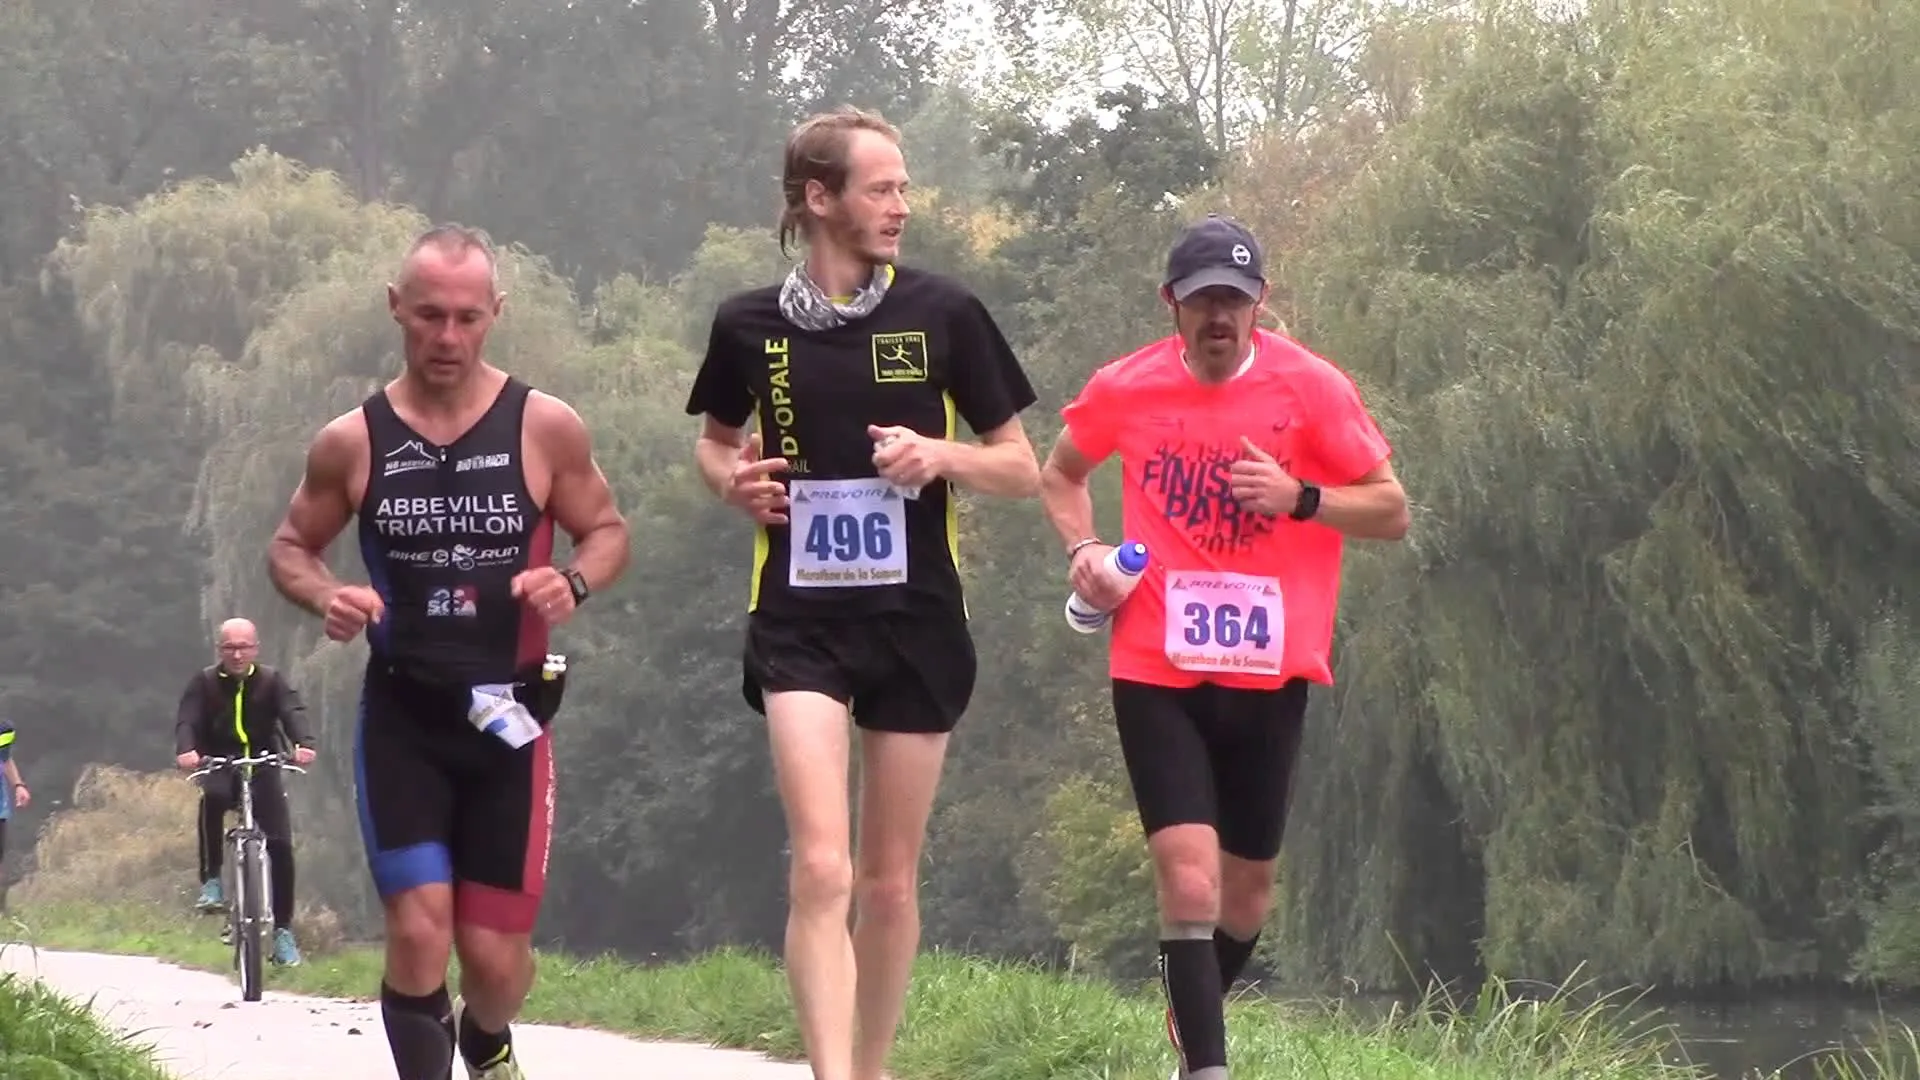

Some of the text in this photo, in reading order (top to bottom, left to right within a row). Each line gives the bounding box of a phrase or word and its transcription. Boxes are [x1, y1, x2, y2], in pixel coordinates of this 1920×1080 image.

[765, 337, 799, 456] D'OPALE
[785, 459, 811, 473] RAIL
[376, 494, 519, 516] ABBEVILLE
[375, 515, 524, 537] TRIATHLON
[805, 512, 892, 562] 496
[842, 568, 856, 580] de
[858, 567, 868, 580] la
[1184, 602, 1271, 650] 364
[1220, 655, 1230, 666] de
[1232, 655, 1241, 666] la
